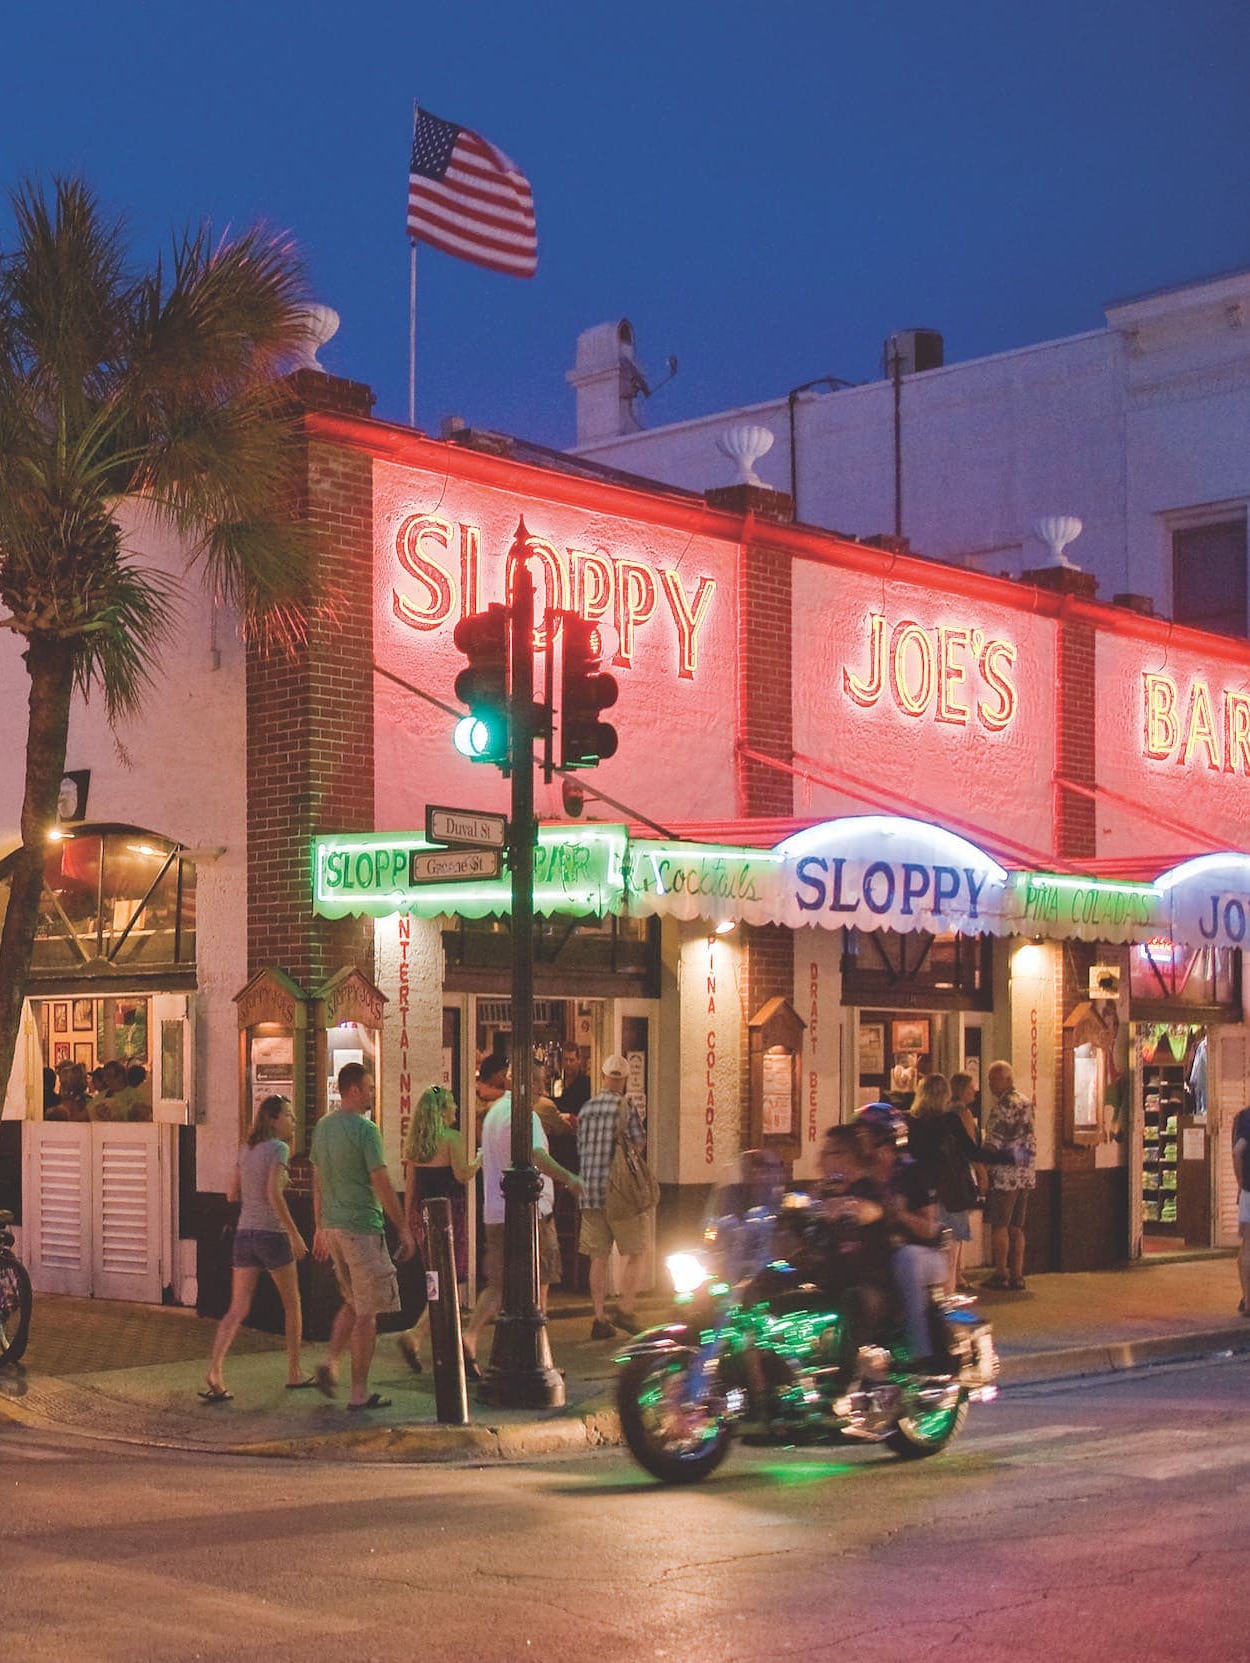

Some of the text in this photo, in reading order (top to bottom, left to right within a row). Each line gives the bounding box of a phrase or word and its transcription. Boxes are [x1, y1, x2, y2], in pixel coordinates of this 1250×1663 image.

[843, 612, 1018, 732] JOE'S
[446, 818, 492, 840] Duval St
[326, 849, 407, 889] SLOPP
[470, 856, 483, 872] St
[795, 856, 989, 919] SLOPPY
[1199, 896, 1250, 943] JO
[398, 912, 411, 1181] NTERTAINMET
[809, 963, 819, 1142] DRAFT BEER
[705, 1031, 716, 1164] COLADAS
